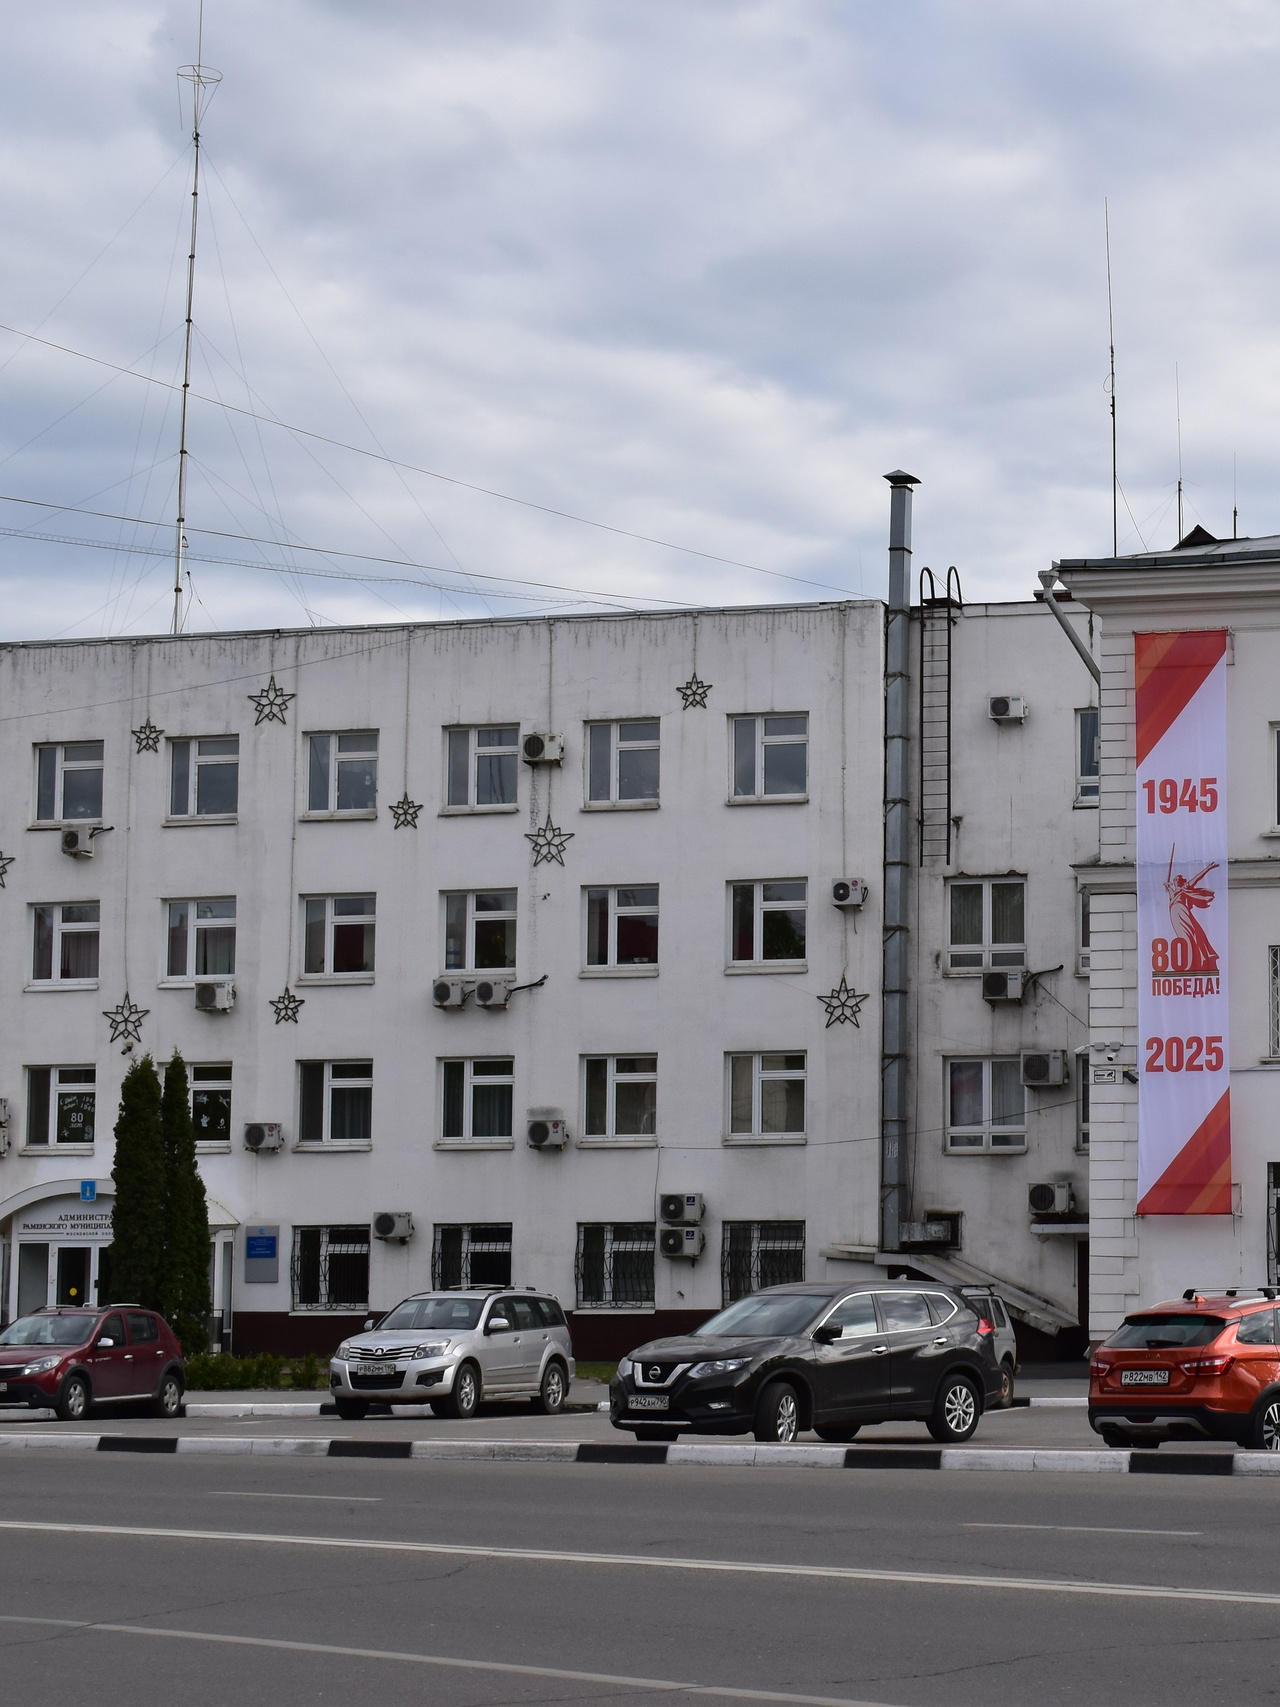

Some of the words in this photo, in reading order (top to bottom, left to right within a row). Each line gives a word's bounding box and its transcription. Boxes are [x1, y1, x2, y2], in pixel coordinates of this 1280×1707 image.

[1142, 777, 1219, 814] 1945
[1151, 937, 1189, 972] 80
[1152, 977, 1221, 998] ПОБЕДА!
[1145, 1035, 1224, 1072] 2025
[70, 1112, 84, 1123] 80
[70, 1223, 113, 1231] МУНИЦИПА
